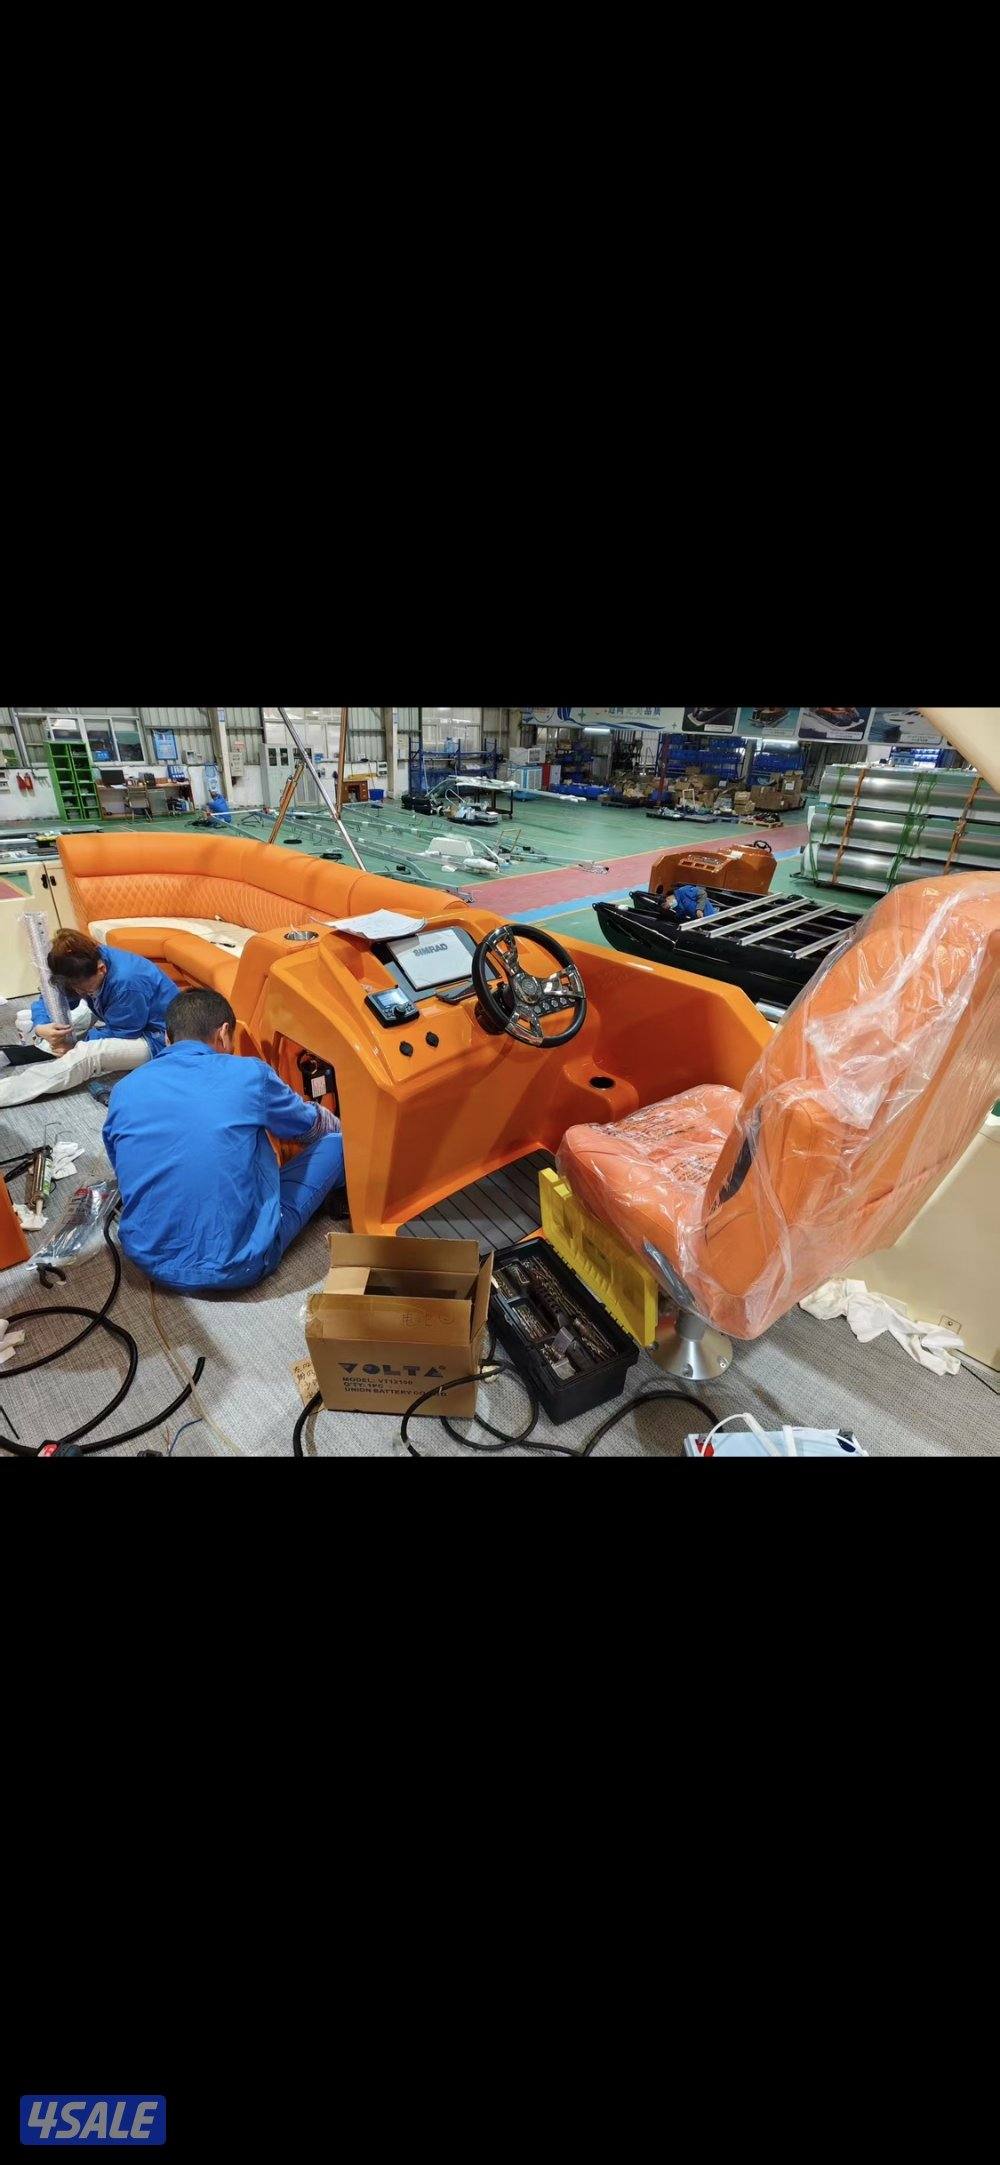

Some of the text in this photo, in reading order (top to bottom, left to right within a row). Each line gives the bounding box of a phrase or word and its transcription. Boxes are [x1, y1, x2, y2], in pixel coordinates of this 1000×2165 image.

[412, 943, 448, 957] SIMRAD
[337, 1363, 443, 1377] VOLTA
[373, 1388, 413, 1396] BATTERY
